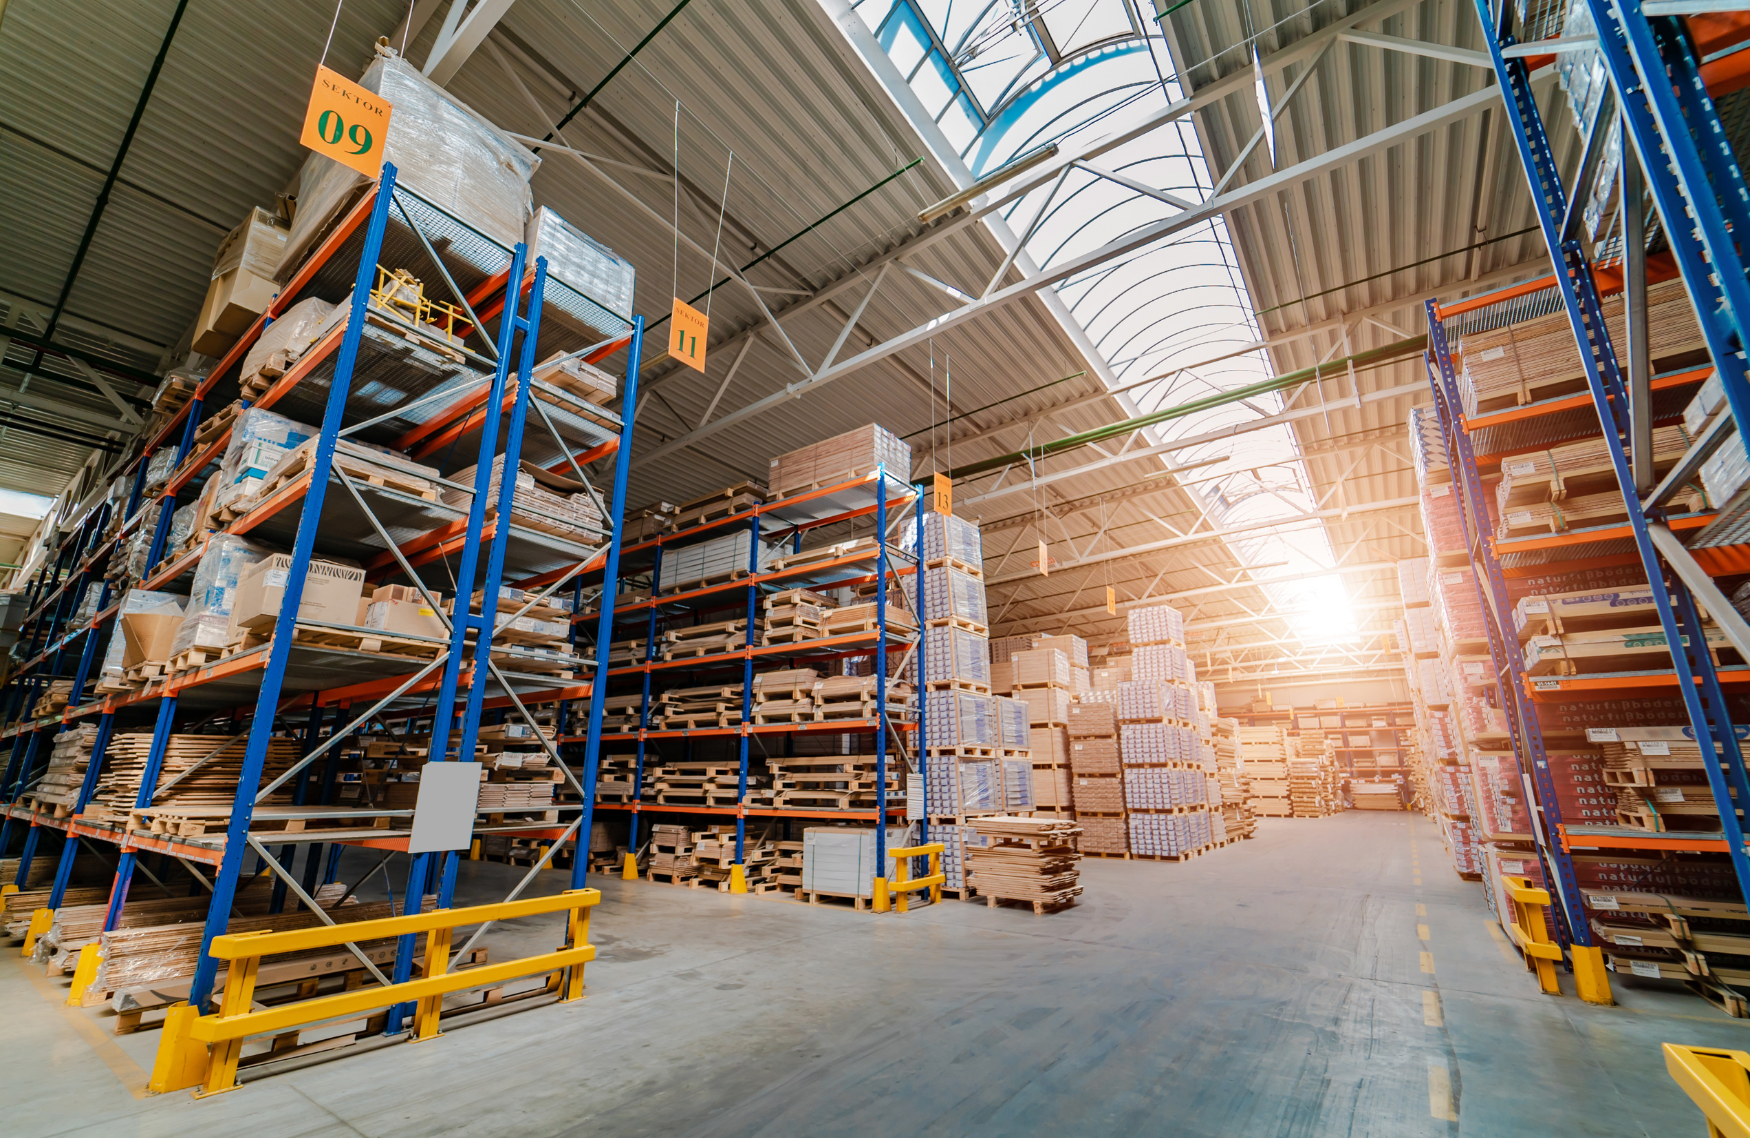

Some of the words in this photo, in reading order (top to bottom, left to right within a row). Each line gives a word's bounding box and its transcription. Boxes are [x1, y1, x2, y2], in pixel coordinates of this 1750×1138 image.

[322, 79, 384, 117] SEKTOR
[318, 110, 373, 155] 09
[675, 307, 705, 329] SEKTOR
[676, 329, 697, 360] 11
[937, 491, 949, 511] 13
